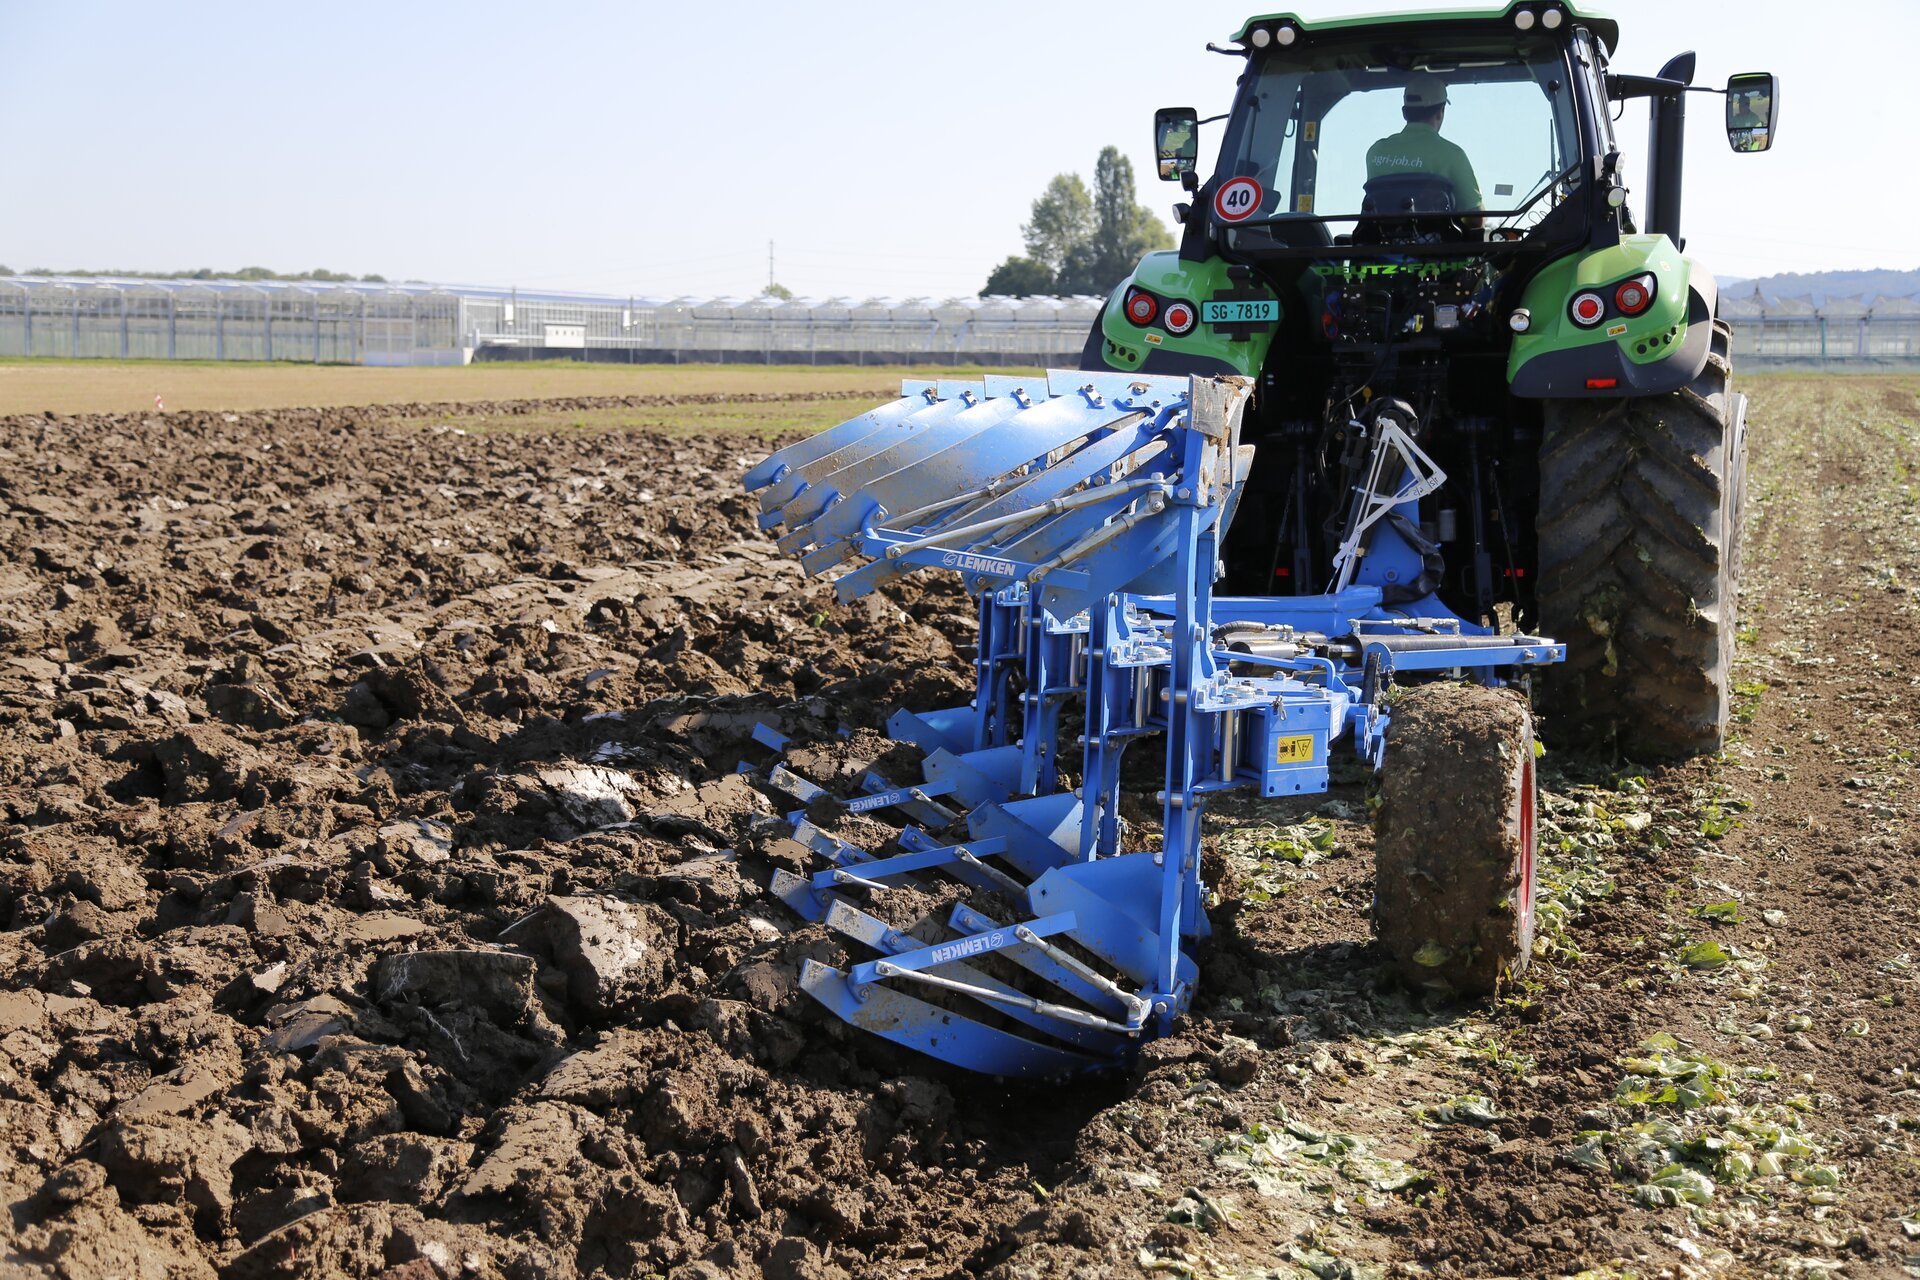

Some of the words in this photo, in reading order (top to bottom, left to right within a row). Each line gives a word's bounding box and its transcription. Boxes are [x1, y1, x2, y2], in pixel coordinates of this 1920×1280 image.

[1226, 189, 1250, 207] 40
[957, 555, 1016, 576] LEMKEN
[931, 936, 990, 963] LEMKEN
